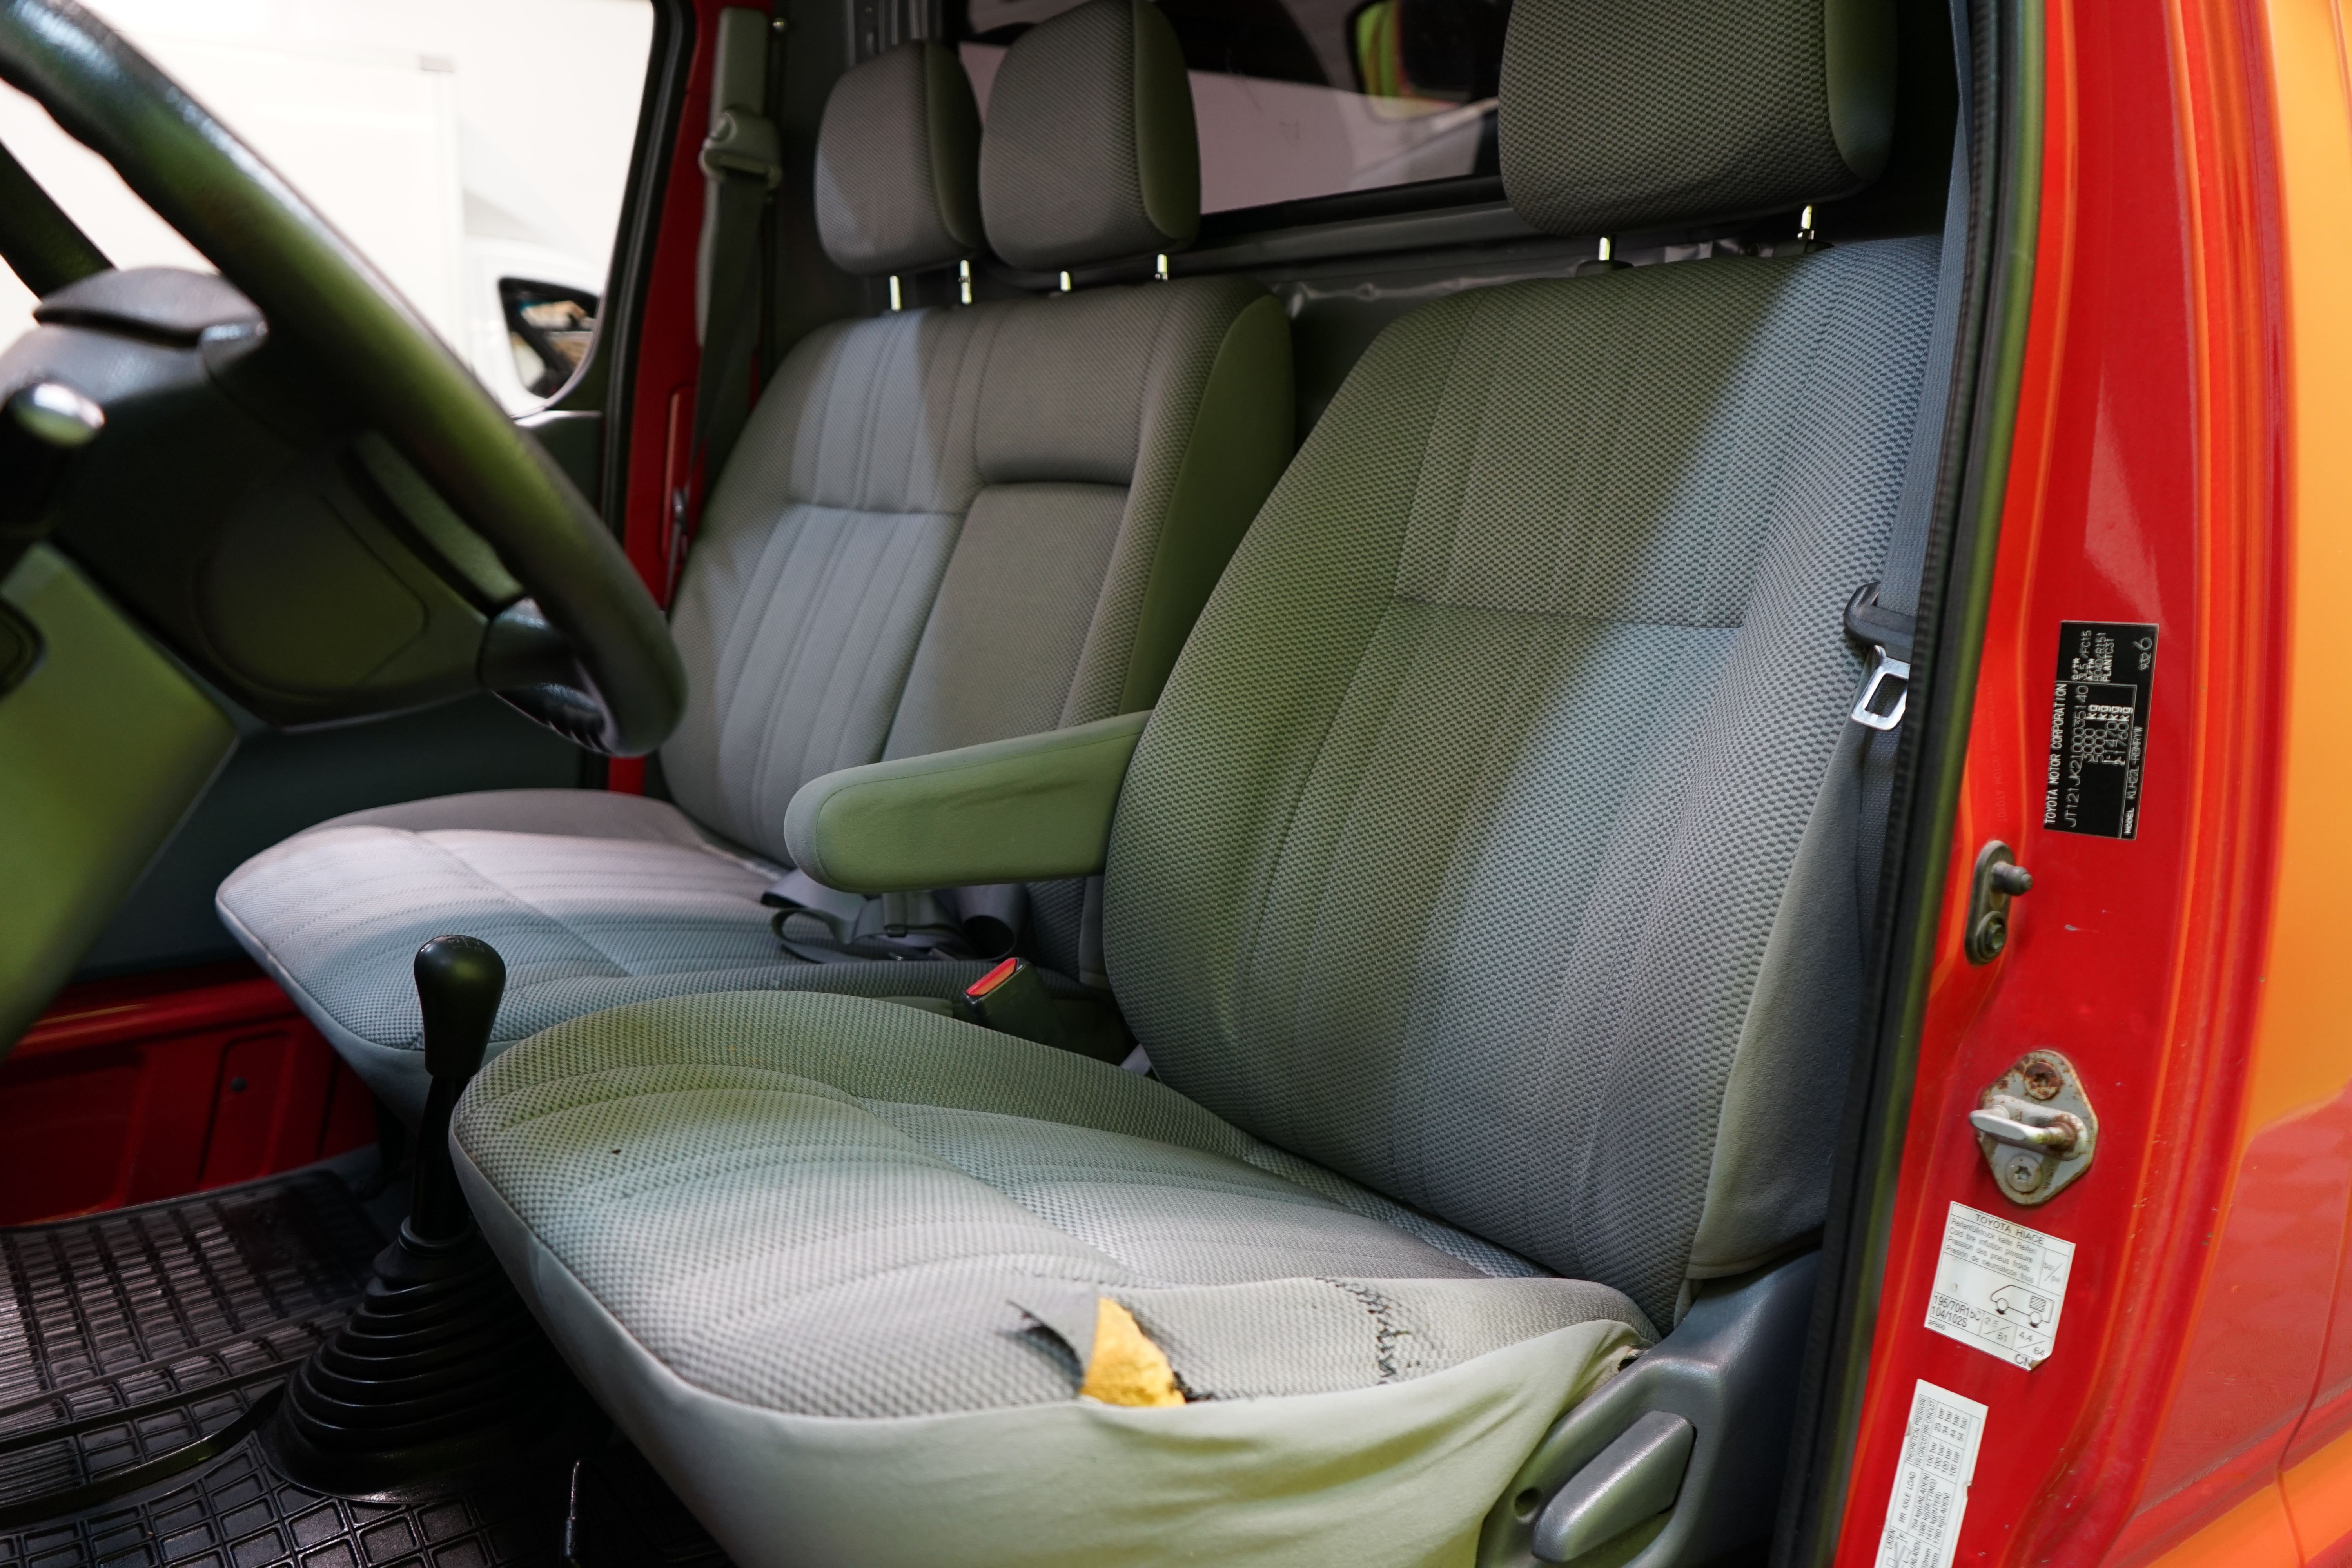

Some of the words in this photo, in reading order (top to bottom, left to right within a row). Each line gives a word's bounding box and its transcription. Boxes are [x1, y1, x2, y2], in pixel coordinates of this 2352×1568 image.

[2051, 684, 2067, 750] CORPORATION
[2086, 704, 2100, 720] kg
[2097, 705, 2111, 721] kg
[2107, 706, 2122, 721] kg
[2119, 707, 2133, 722] kg
[2083, 728, 2095, 763] 3000
[2093, 729, 2106, 764] 5000
[2064, 685, 2089, 828] JT121JK2100035140
[2047, 754, 2061, 784] MOTOR
[2045, 789, 2058, 824] TOYOTA
[2124, 807, 2134, 835] MODEL
[1976, 1214, 2011, 1233] TOYOTA
[2016, 1229, 2045, 1245] HIACE
[1950, 1227, 1964, 1237] Cold
[1966, 1233, 1976, 1242] tire
[1979, 1238, 2003, 1252] inflation
[2005, 1249, 2034, 1263] pressure
[2017, 1242, 2037, 1255] Reifen
[1948, 1236, 1973, 1251] Pression
[1976, 1247, 1988, 1256] des
[1990, 1254, 2010, 1264] pneus
[2014, 1259, 2031, 1272] froids
[1932, 1306, 1968, 1327] 104/102S
[1998, 1332, 2007, 1342] 51
[2019, 1332, 2033, 1343] 4.4
[2033, 1347, 2045, 1356] 64
[1926, 1399, 1937, 1424] CIRCUIT
[1936, 1408, 1945, 1419] bar
[1944, 1411, 1953, 1422] bar
[1952, 1414, 1960, 1426] bar
[1960, 1417, 1969, 1430] bar
[1906, 1427, 1920, 1462] THEORETICAL
[1915, 1398, 1927, 1426] PRESSURE
[1924, 1423, 1931, 1434] RR
[1918, 1434, 1928, 1457] CIRCUIT
[1936, 1444, 1945, 1457] bar
[1944, 1448, 1953, 1460] bar
[1952, 1452, 1960, 1463] bar
[1941, 1461, 1949, 1474] 100
[1949, 1464, 1957, 1477] 100
[1906, 1471, 1916, 1490] LOAD
[1902, 1492, 1912, 1510] AXLE
[1898, 1512, 1906, 1523] RR
[1885, 1528, 1896, 1549] LADEN
